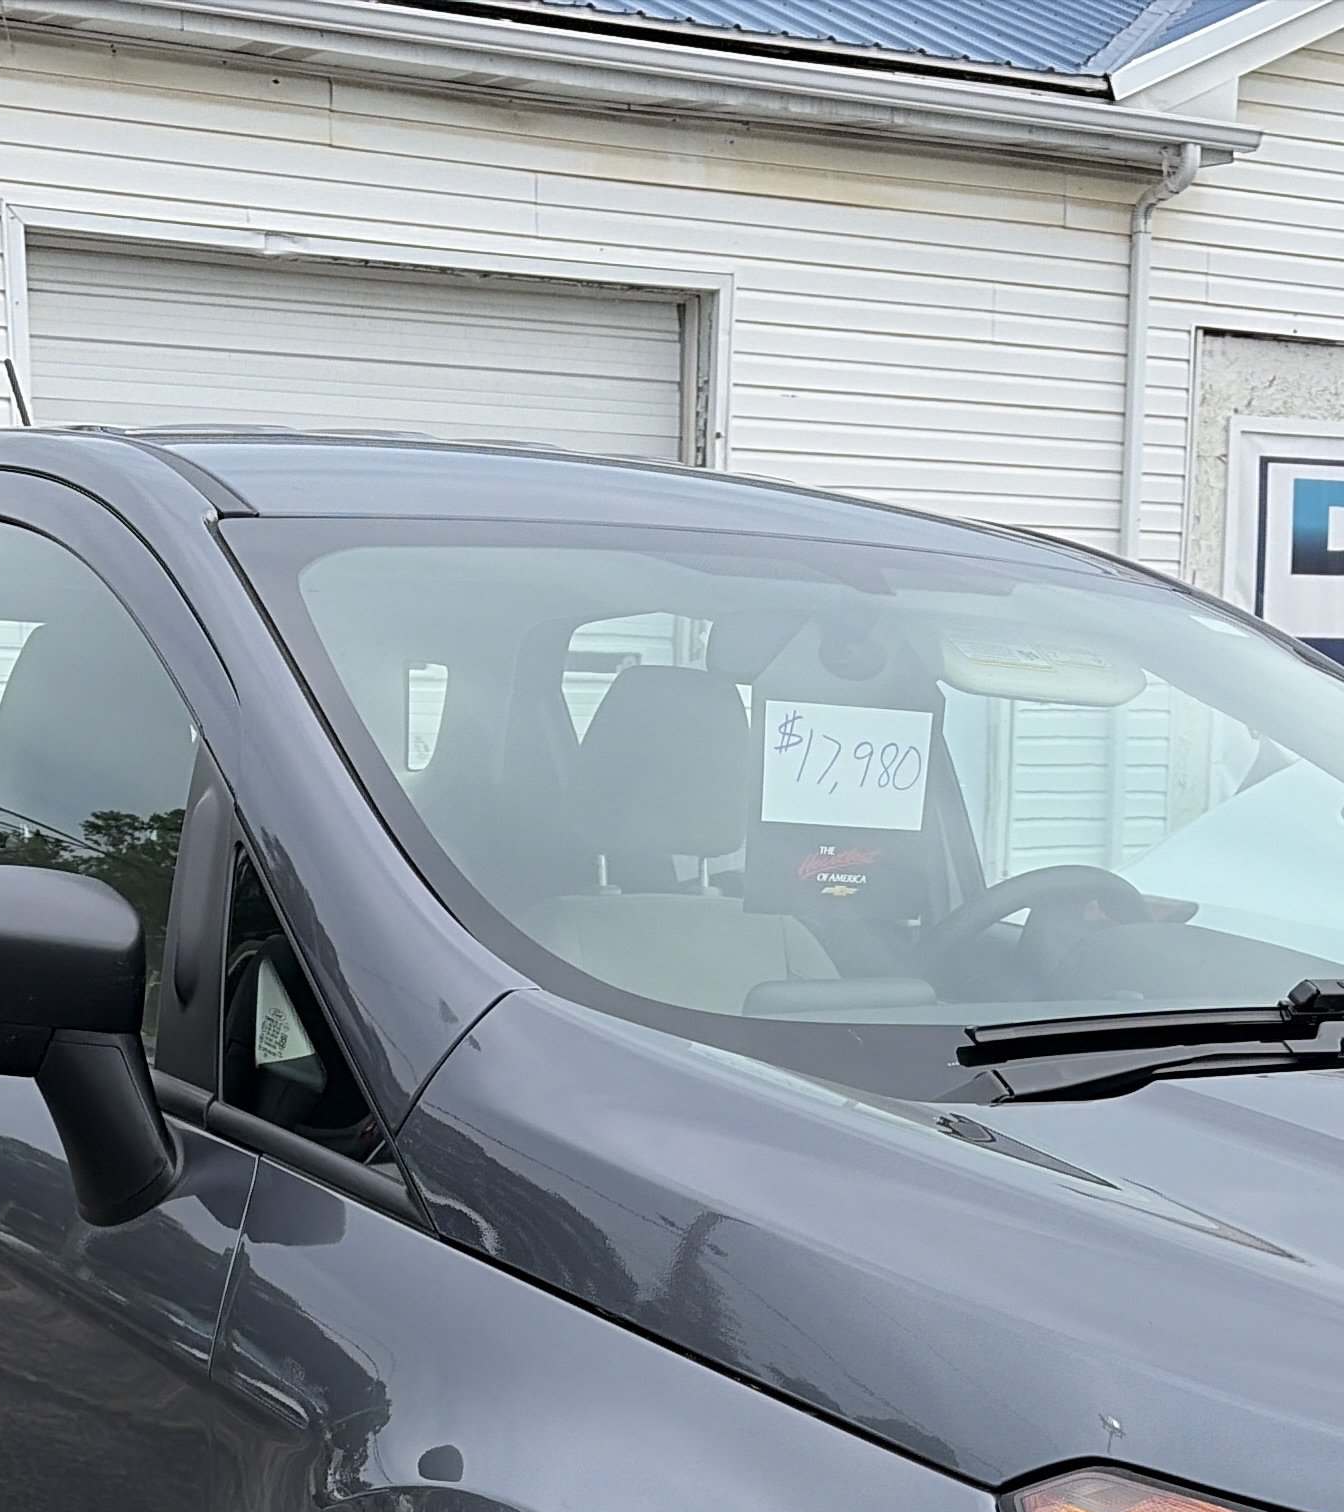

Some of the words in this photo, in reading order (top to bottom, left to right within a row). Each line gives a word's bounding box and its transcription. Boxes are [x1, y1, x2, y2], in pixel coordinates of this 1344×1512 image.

[774, 710, 922, 794] $17,980
[819, 846, 836, 856] THE
[816, 873, 830, 882] OF
[828, 873, 867, 884] AMERICA
